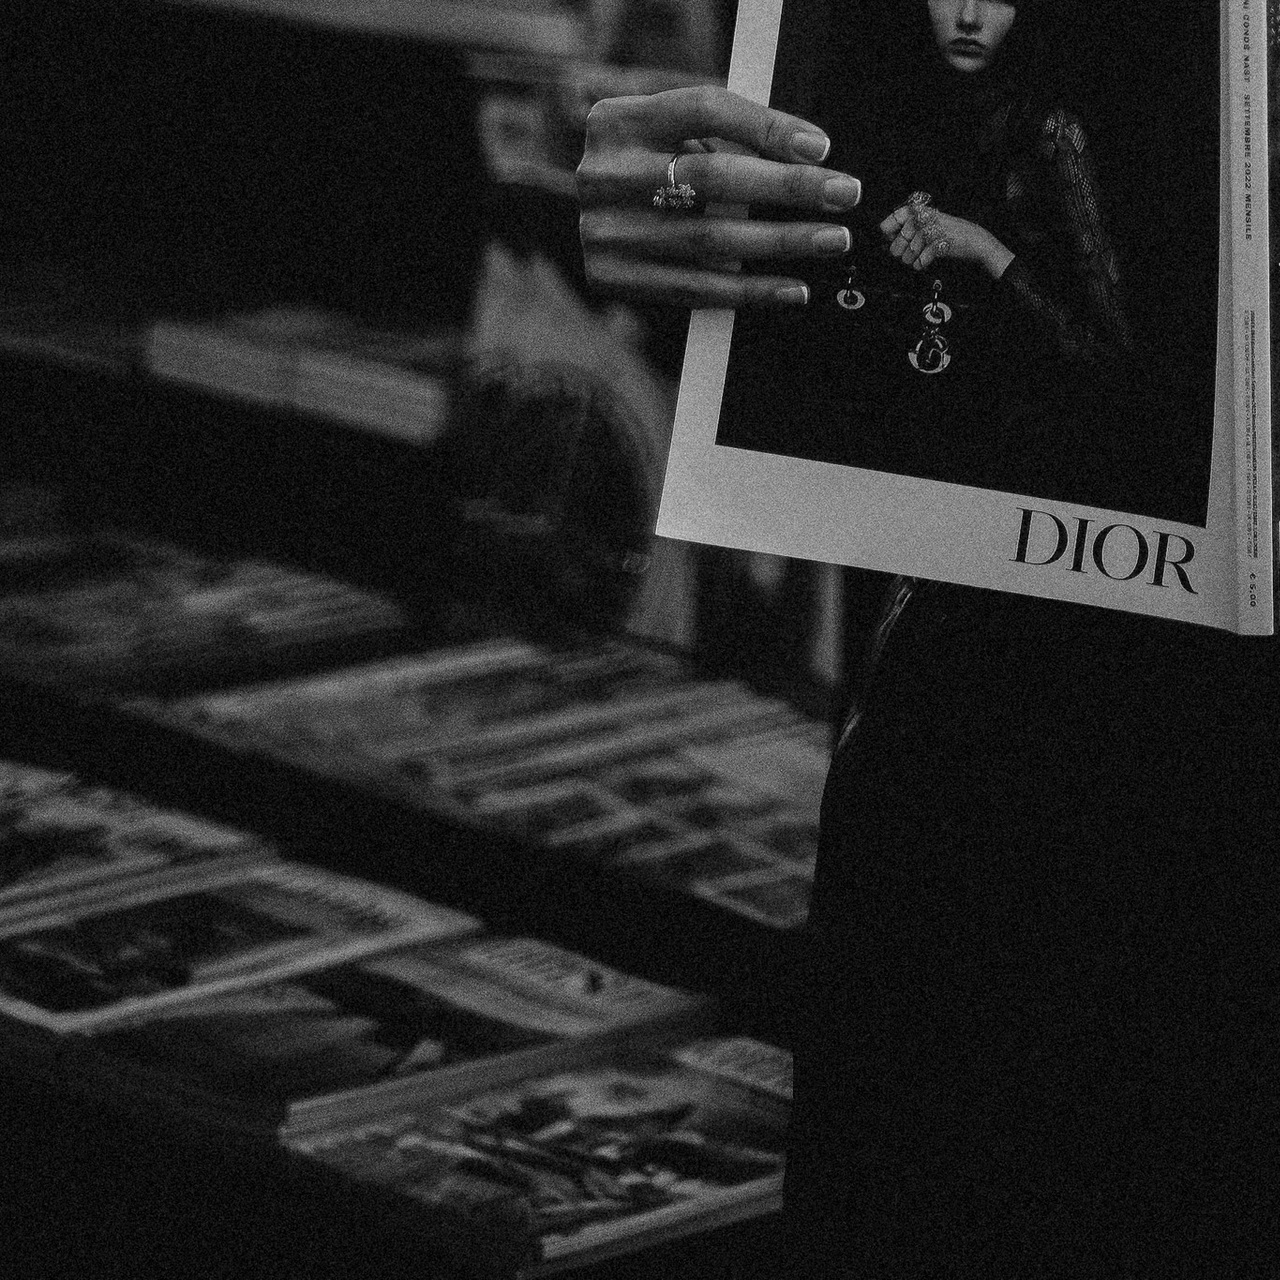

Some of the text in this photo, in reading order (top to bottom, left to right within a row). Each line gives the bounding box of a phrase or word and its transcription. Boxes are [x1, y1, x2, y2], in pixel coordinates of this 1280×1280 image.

[1244, 94, 1252, 158] SETTEMBRE
[1244, 162, 1252, 189] 2022
[1245, 193, 1253, 241] MENSILE
[1008, 507, 1199, 594] DIOR
[1249, 583, 1257, 608] 5.00
